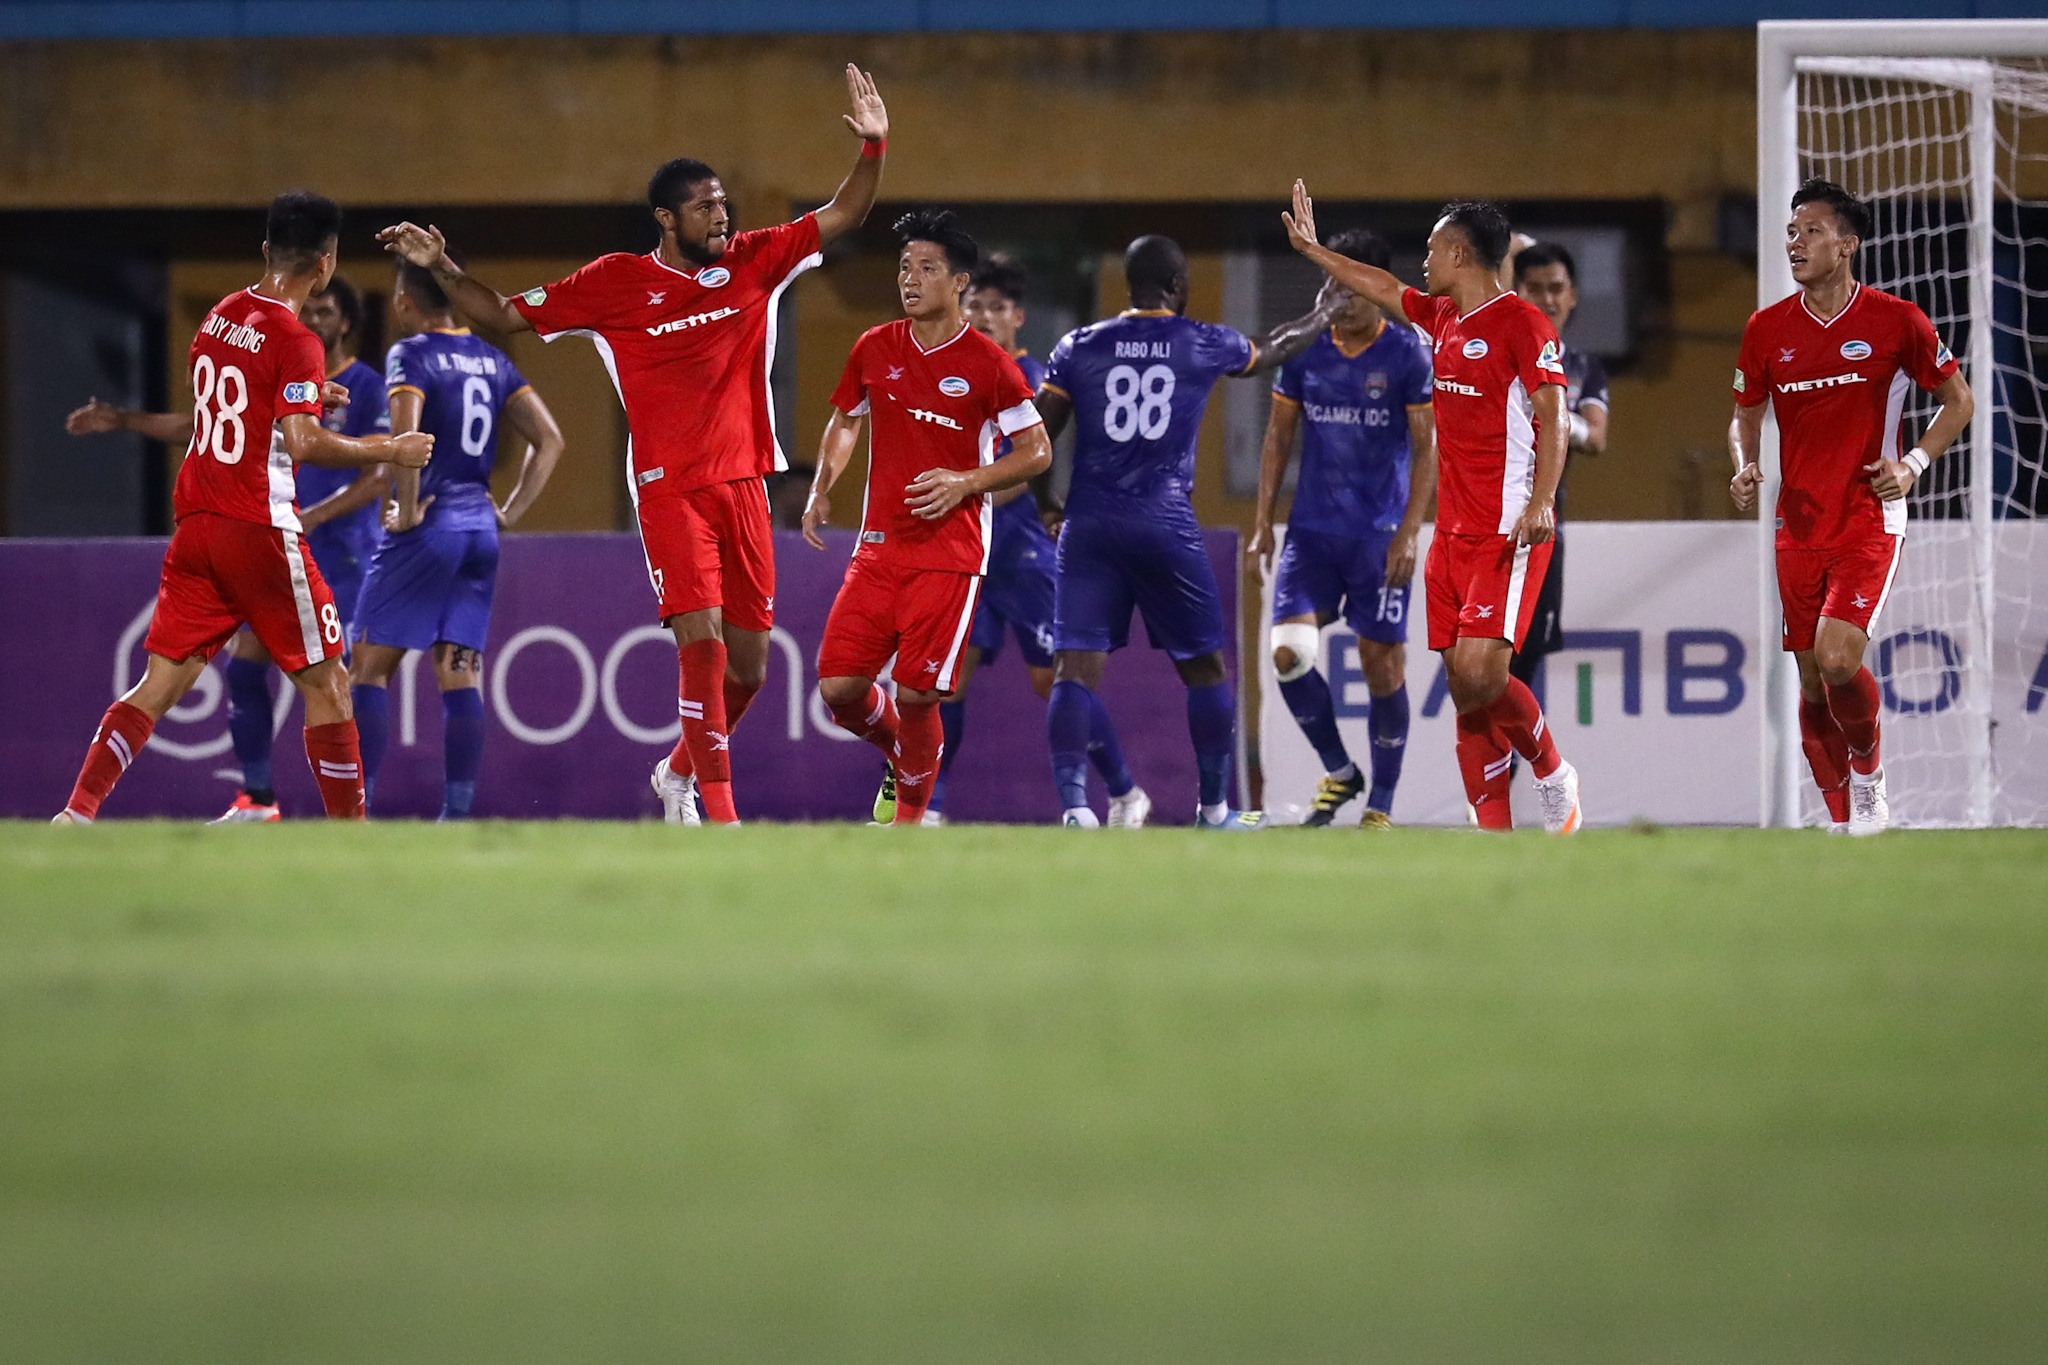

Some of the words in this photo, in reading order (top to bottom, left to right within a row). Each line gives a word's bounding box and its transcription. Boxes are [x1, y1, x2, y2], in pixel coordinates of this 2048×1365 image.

[645, 306, 740, 337] VIETTEL
[1115, 341, 1148, 359] RABO
[1150, 341, 1171, 359] ALI
[1776, 372, 1868, 394] VIETTEL
[193, 354, 249, 465] 88
[461, 375, 493, 458] 6
[1103, 363, 1176, 443] 88
[1303, 401, 1361, 425] CAMEX
[1364, 407, 1390, 427] IDC
[320, 602, 342, 645] 8
[1376, 586, 1404, 624] 15
